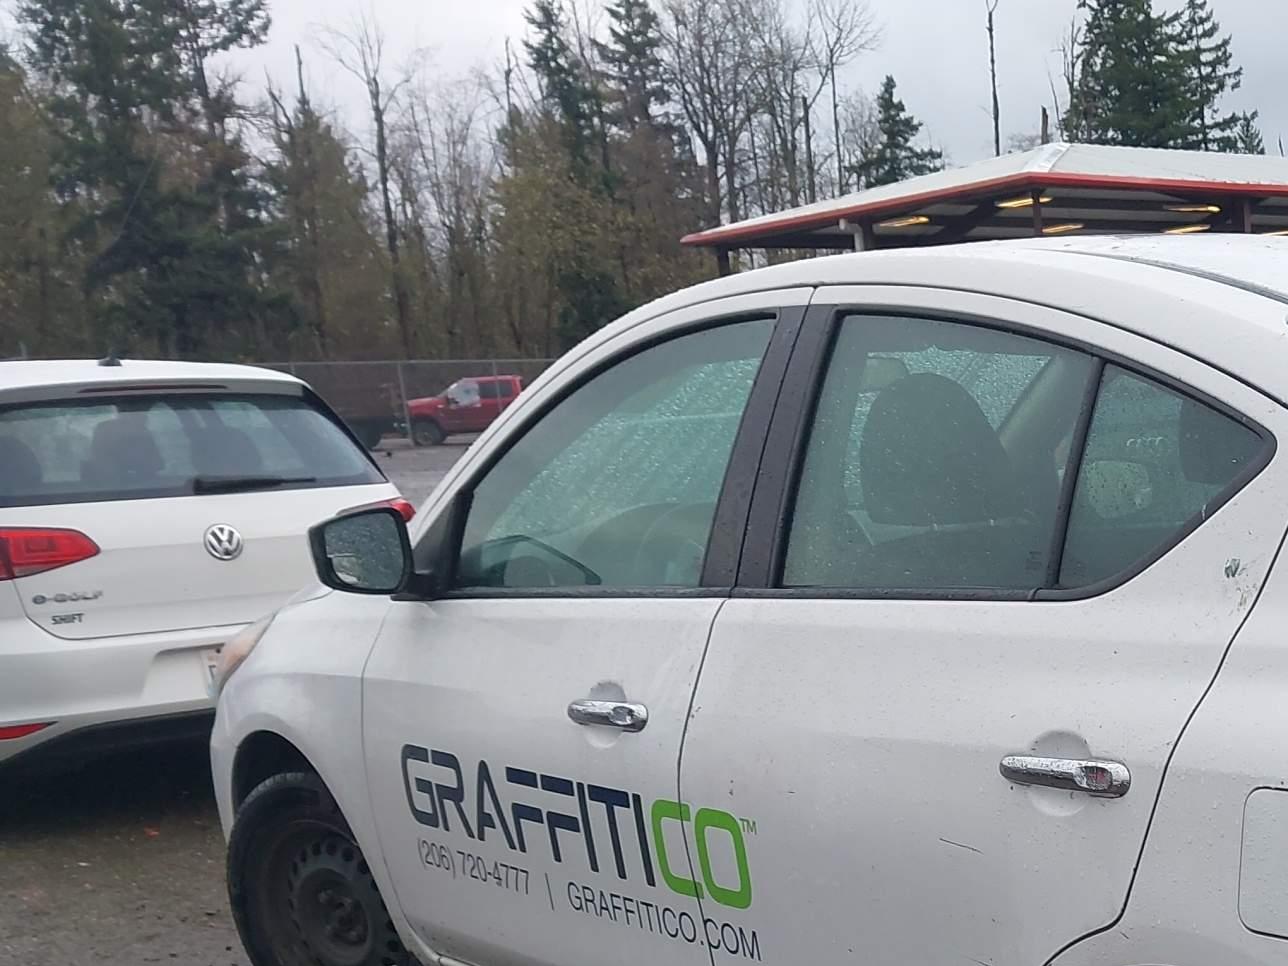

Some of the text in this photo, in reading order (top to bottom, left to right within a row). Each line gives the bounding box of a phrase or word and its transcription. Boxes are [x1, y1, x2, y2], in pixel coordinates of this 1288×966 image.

[401, 744, 752, 909] GRAFFITICO
[417, 838, 456, 880] (206)
[456, 850, 530, 895] 720-4777
[567, 881, 762, 962] GRAFFITICO.COM
